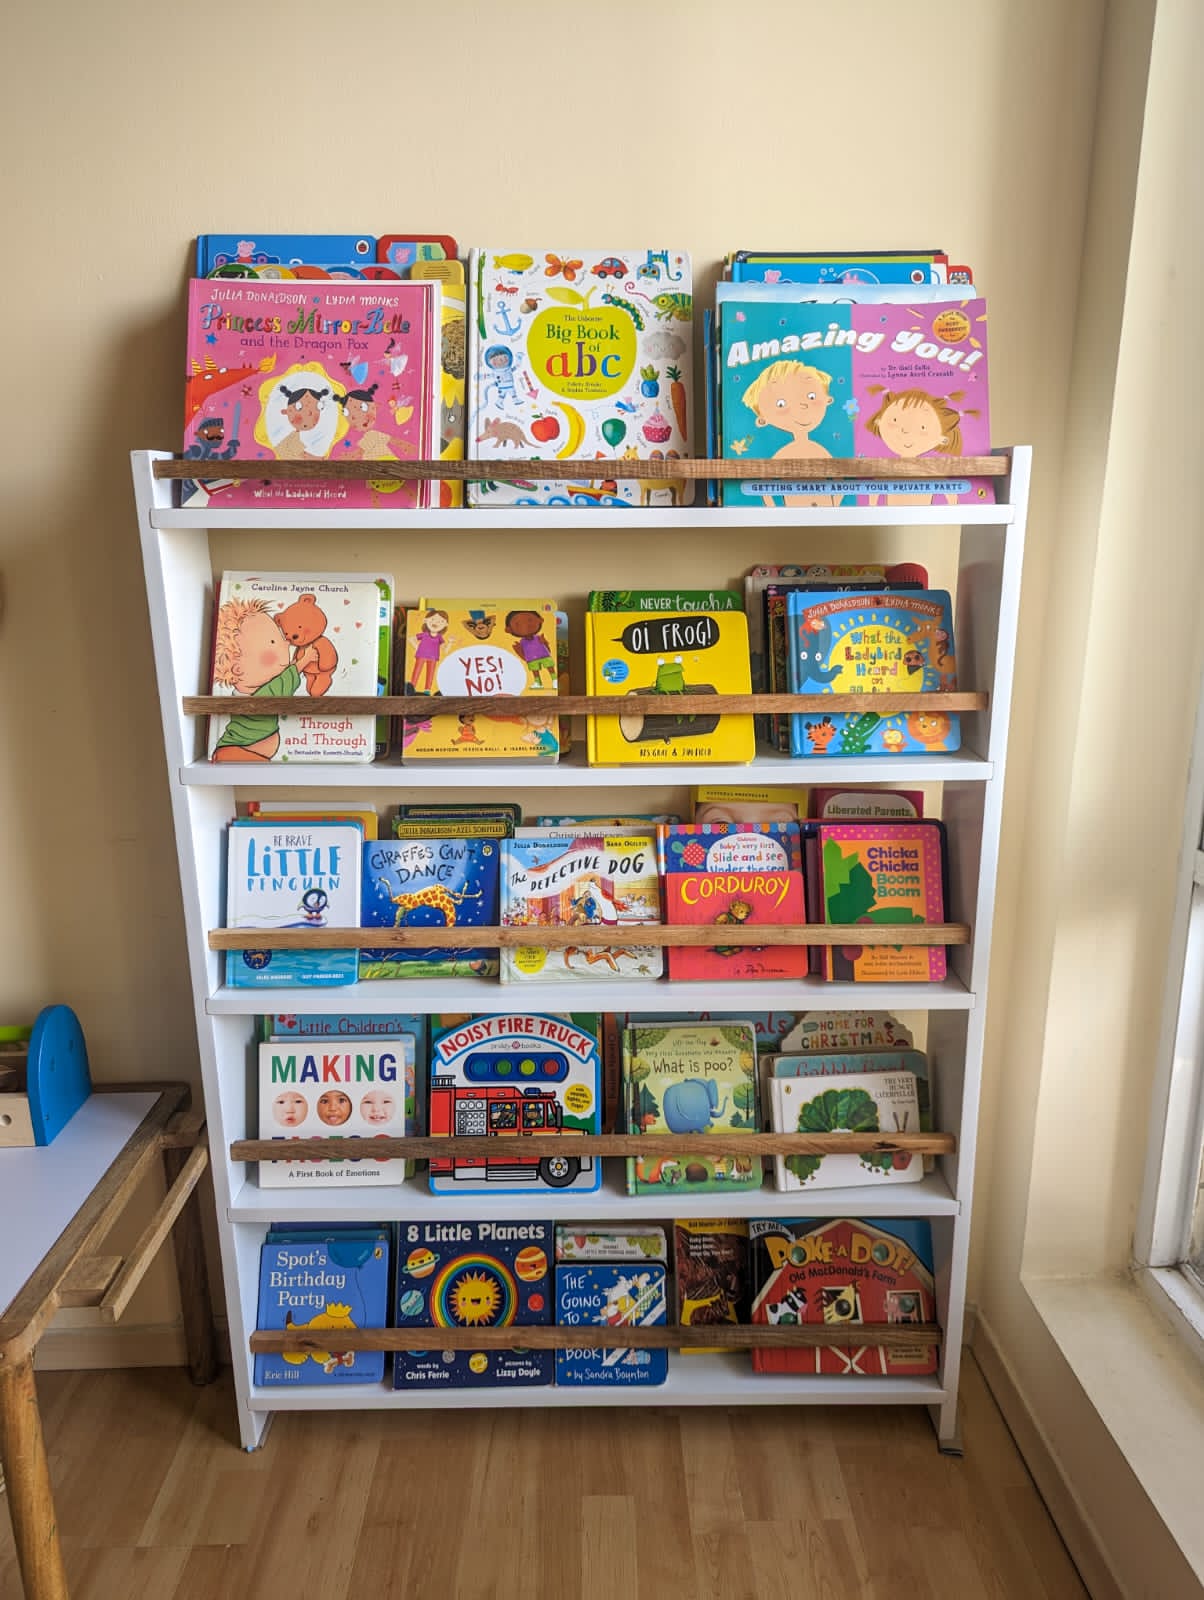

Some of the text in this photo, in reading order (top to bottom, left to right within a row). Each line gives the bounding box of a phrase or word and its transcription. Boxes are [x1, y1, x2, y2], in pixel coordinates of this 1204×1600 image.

[211, 289, 307, 304] JULIA DONALDSON
[326, 296, 355, 304] LYDIA
[200, 303, 410, 334] Princess Mirror-Belle
[546, 324, 620, 344] Big Book
[240, 335, 368, 353] and the Dragon Pox
[589, 343, 600, 352] of
[727, 323, 885, 367] Amazing
[546, 341, 622, 378] abc
[752, 483, 962, 492] GETTING SMART ABOUT YOUR PRIVATE PARTS
[251, 583, 349, 594] Caroline Jayne Church
[640, 592, 733, 612] NEVER touch A
[808, 606, 828, 618] JULIA
[662, 618, 712, 650] FROG!
[850, 629, 902, 645] What the
[845, 646, 902, 665] Ladybird
[459, 656, 504, 676] YES!
[856, 662, 898, 676] Heard
[465, 674, 502, 696] NO!
[299, 717, 352, 732] Through
[284, 733, 367, 749] and Through
[827, 805, 871, 815] Liberated
[273, 835, 312, 847] BE BRAVE
[371, 844, 475, 870] GIRAFFES CAN'T
[713, 851, 739, 862] Slide
[742, 851, 762, 862] and
[867, 847, 919, 859] Chicka
[396, 864, 455, 884] DANCE
[511, 853, 644, 892] The DETECTIVE DOG
[868, 861, 919, 872] Chicka
[247, 877, 340, 891] PENGUIN
[876, 873, 920, 884] Boom
[680, 874, 791, 912] CORDUROY
[877, 885, 921, 897] Boom
[299, 1018, 403, 1034] Little Children's
[820, 1017, 874, 1031] HOME FOR
[441, 1018, 592, 1057] NOISY FIRE TRUCK
[801, 1031, 895, 1049] CHRISTMAS
[271, 1054, 397, 1083] MAKING
[653, 1057, 733, 1077] What is poo?
[346, 1169, 380, 1177] Emotions
[407, 1223, 545, 1242] 8 Little Planets
[752, 1223, 767, 1233] TRY
[277, 1250, 326, 1269] Spot's
[270, 1271, 346, 1289] Birthday
[563, 1272, 587, 1290] THE
[789, 1265, 897, 1285] Old MacDonald's Farm
[277, 1291, 325, 1308] Party
[561, 1292, 600, 1310] GOING
[564, 1311, 580, 1324] TO
[566, 1348, 600, 1360] BOOK
[265, 1370, 299, 1379] Eric Hill
[406, 1371, 449, 1380] Chris Ferrie
[496, 1367, 540, 1378] Lizzy Doyle
[574, 1367, 649, 1383] by Sandra Boynton
